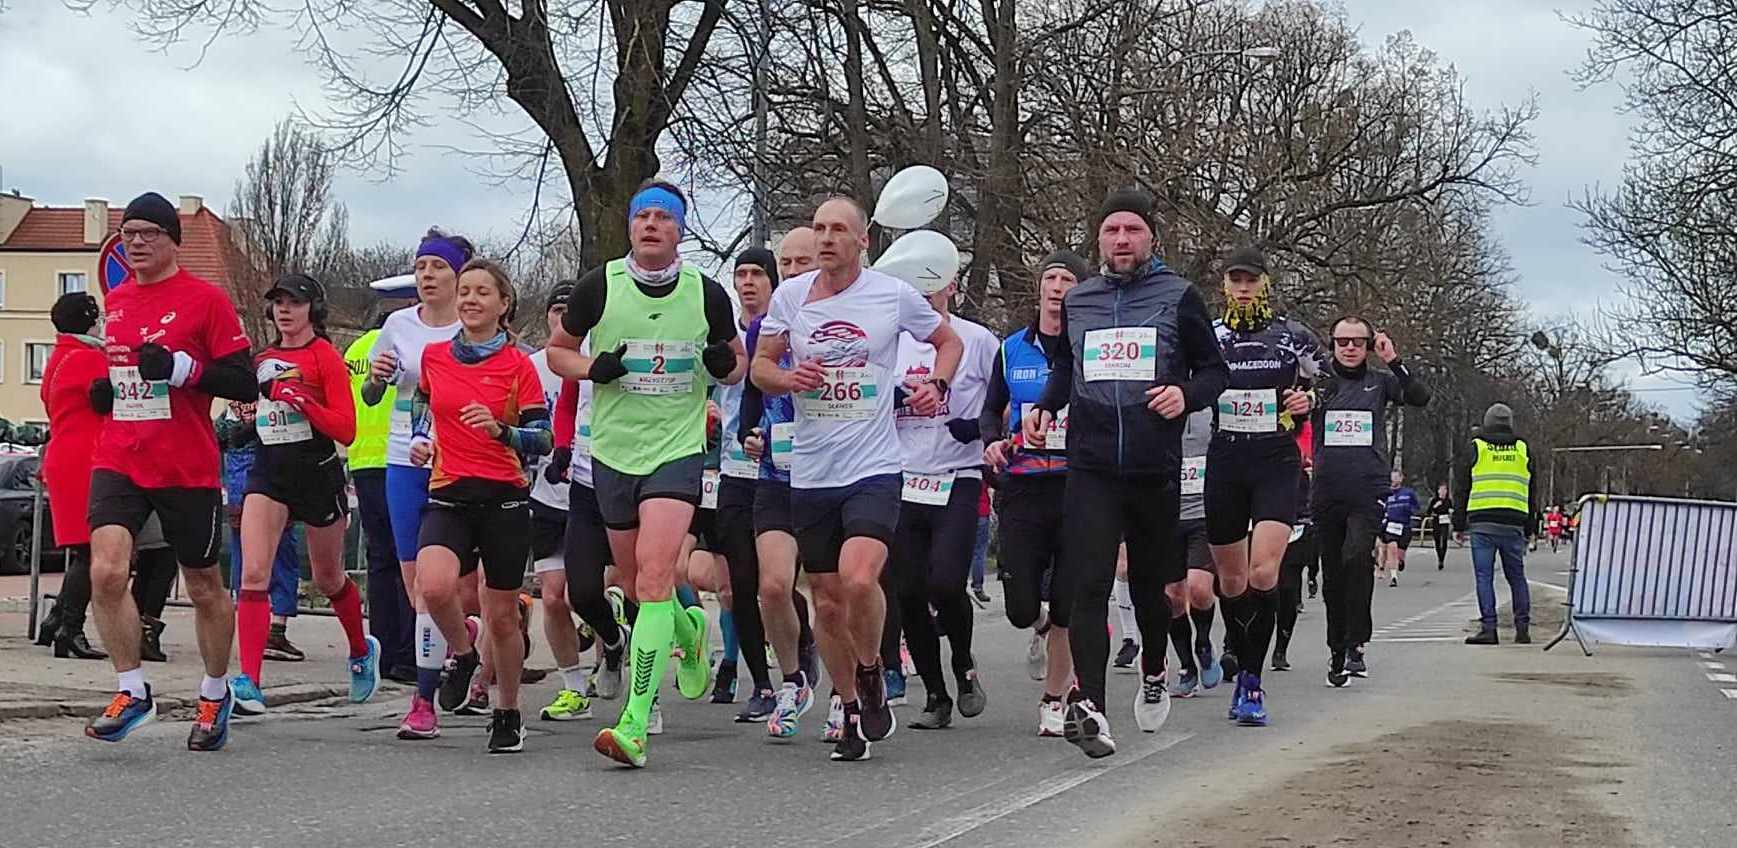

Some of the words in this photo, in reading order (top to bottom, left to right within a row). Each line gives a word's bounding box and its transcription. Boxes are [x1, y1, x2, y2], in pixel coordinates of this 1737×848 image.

[1098, 342, 1140, 361] 320
[652, 355, 665, 375] 2
[1012, 369, 1037, 380] IRON
[118, 381, 153, 401] 342
[820, 382, 861, 401] 266
[1232, 400, 1264, 416] 124
[1335, 420, 1362, 433] 255
[907, 477, 941, 492] 404
